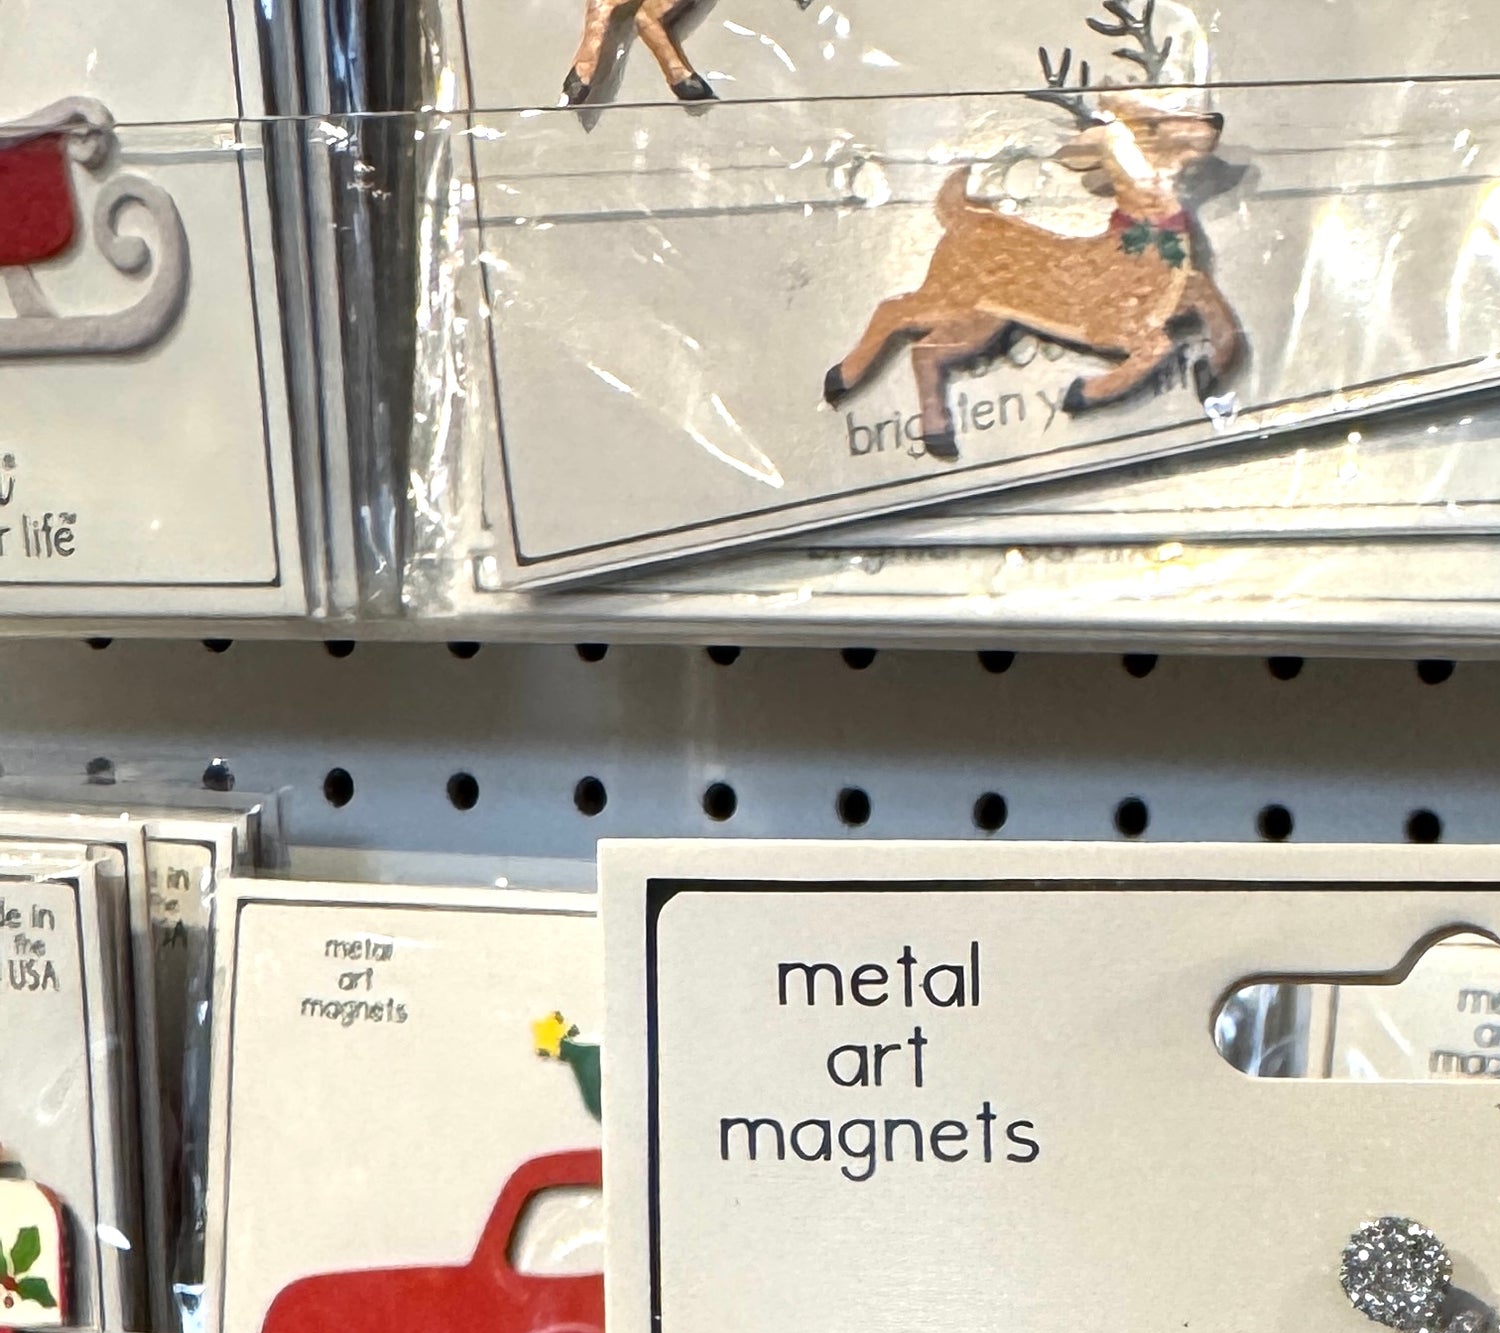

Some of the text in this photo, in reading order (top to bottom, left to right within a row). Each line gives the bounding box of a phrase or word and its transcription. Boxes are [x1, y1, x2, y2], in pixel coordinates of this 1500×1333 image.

[8, 959, 60, 992] USA
[777, 941, 980, 1008] metal
[301, 997, 408, 1028] magnets
[827, 1026, 928, 1088] art
[720, 1101, 1040, 1183] magnets
